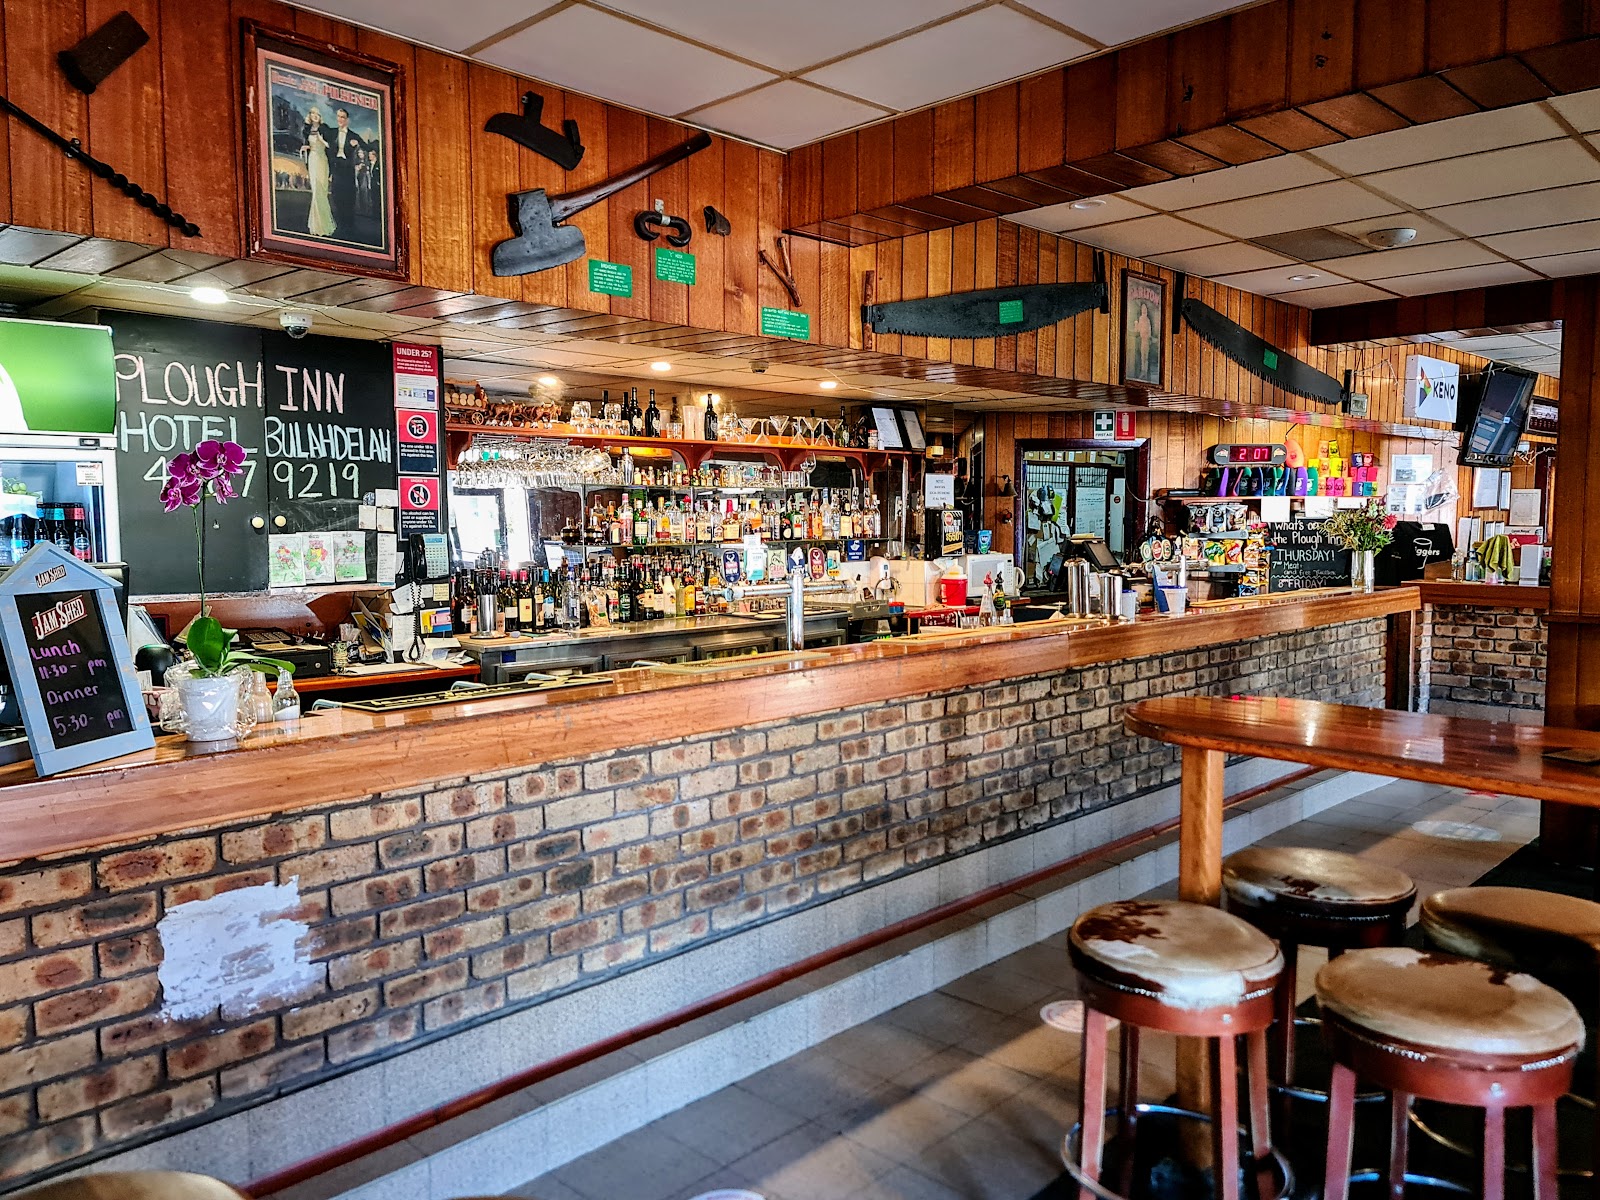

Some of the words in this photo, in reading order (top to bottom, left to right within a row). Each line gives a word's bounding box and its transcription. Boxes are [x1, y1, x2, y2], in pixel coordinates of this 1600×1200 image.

[396, 347, 420, 357] UNDER
[420, 350, 433, 358] 25?
[114, 353, 263, 408] PLOUGH
[275, 364, 345, 415] INN
[1432, 381, 1456, 401] KENO
[120, 410, 258, 454] HOTEL
[264, 416, 392, 465] BULAHDELAH
[273, 460, 360, 499] 9219
[1292, 531, 1323, 550] Plough
[1276, 549, 1335, 562] THURSDAY!
[36, 573, 51, 589] JAM
[48, 565, 67, 583] SHED
[34, 610, 60, 641] JAM
[55, 598, 85, 629] SHED
[30, 639, 81, 660] Lunch
[87, 659, 107, 676] pm
[46, 685, 99, 705] Dinner
[106, 708, 125, 729] pm
